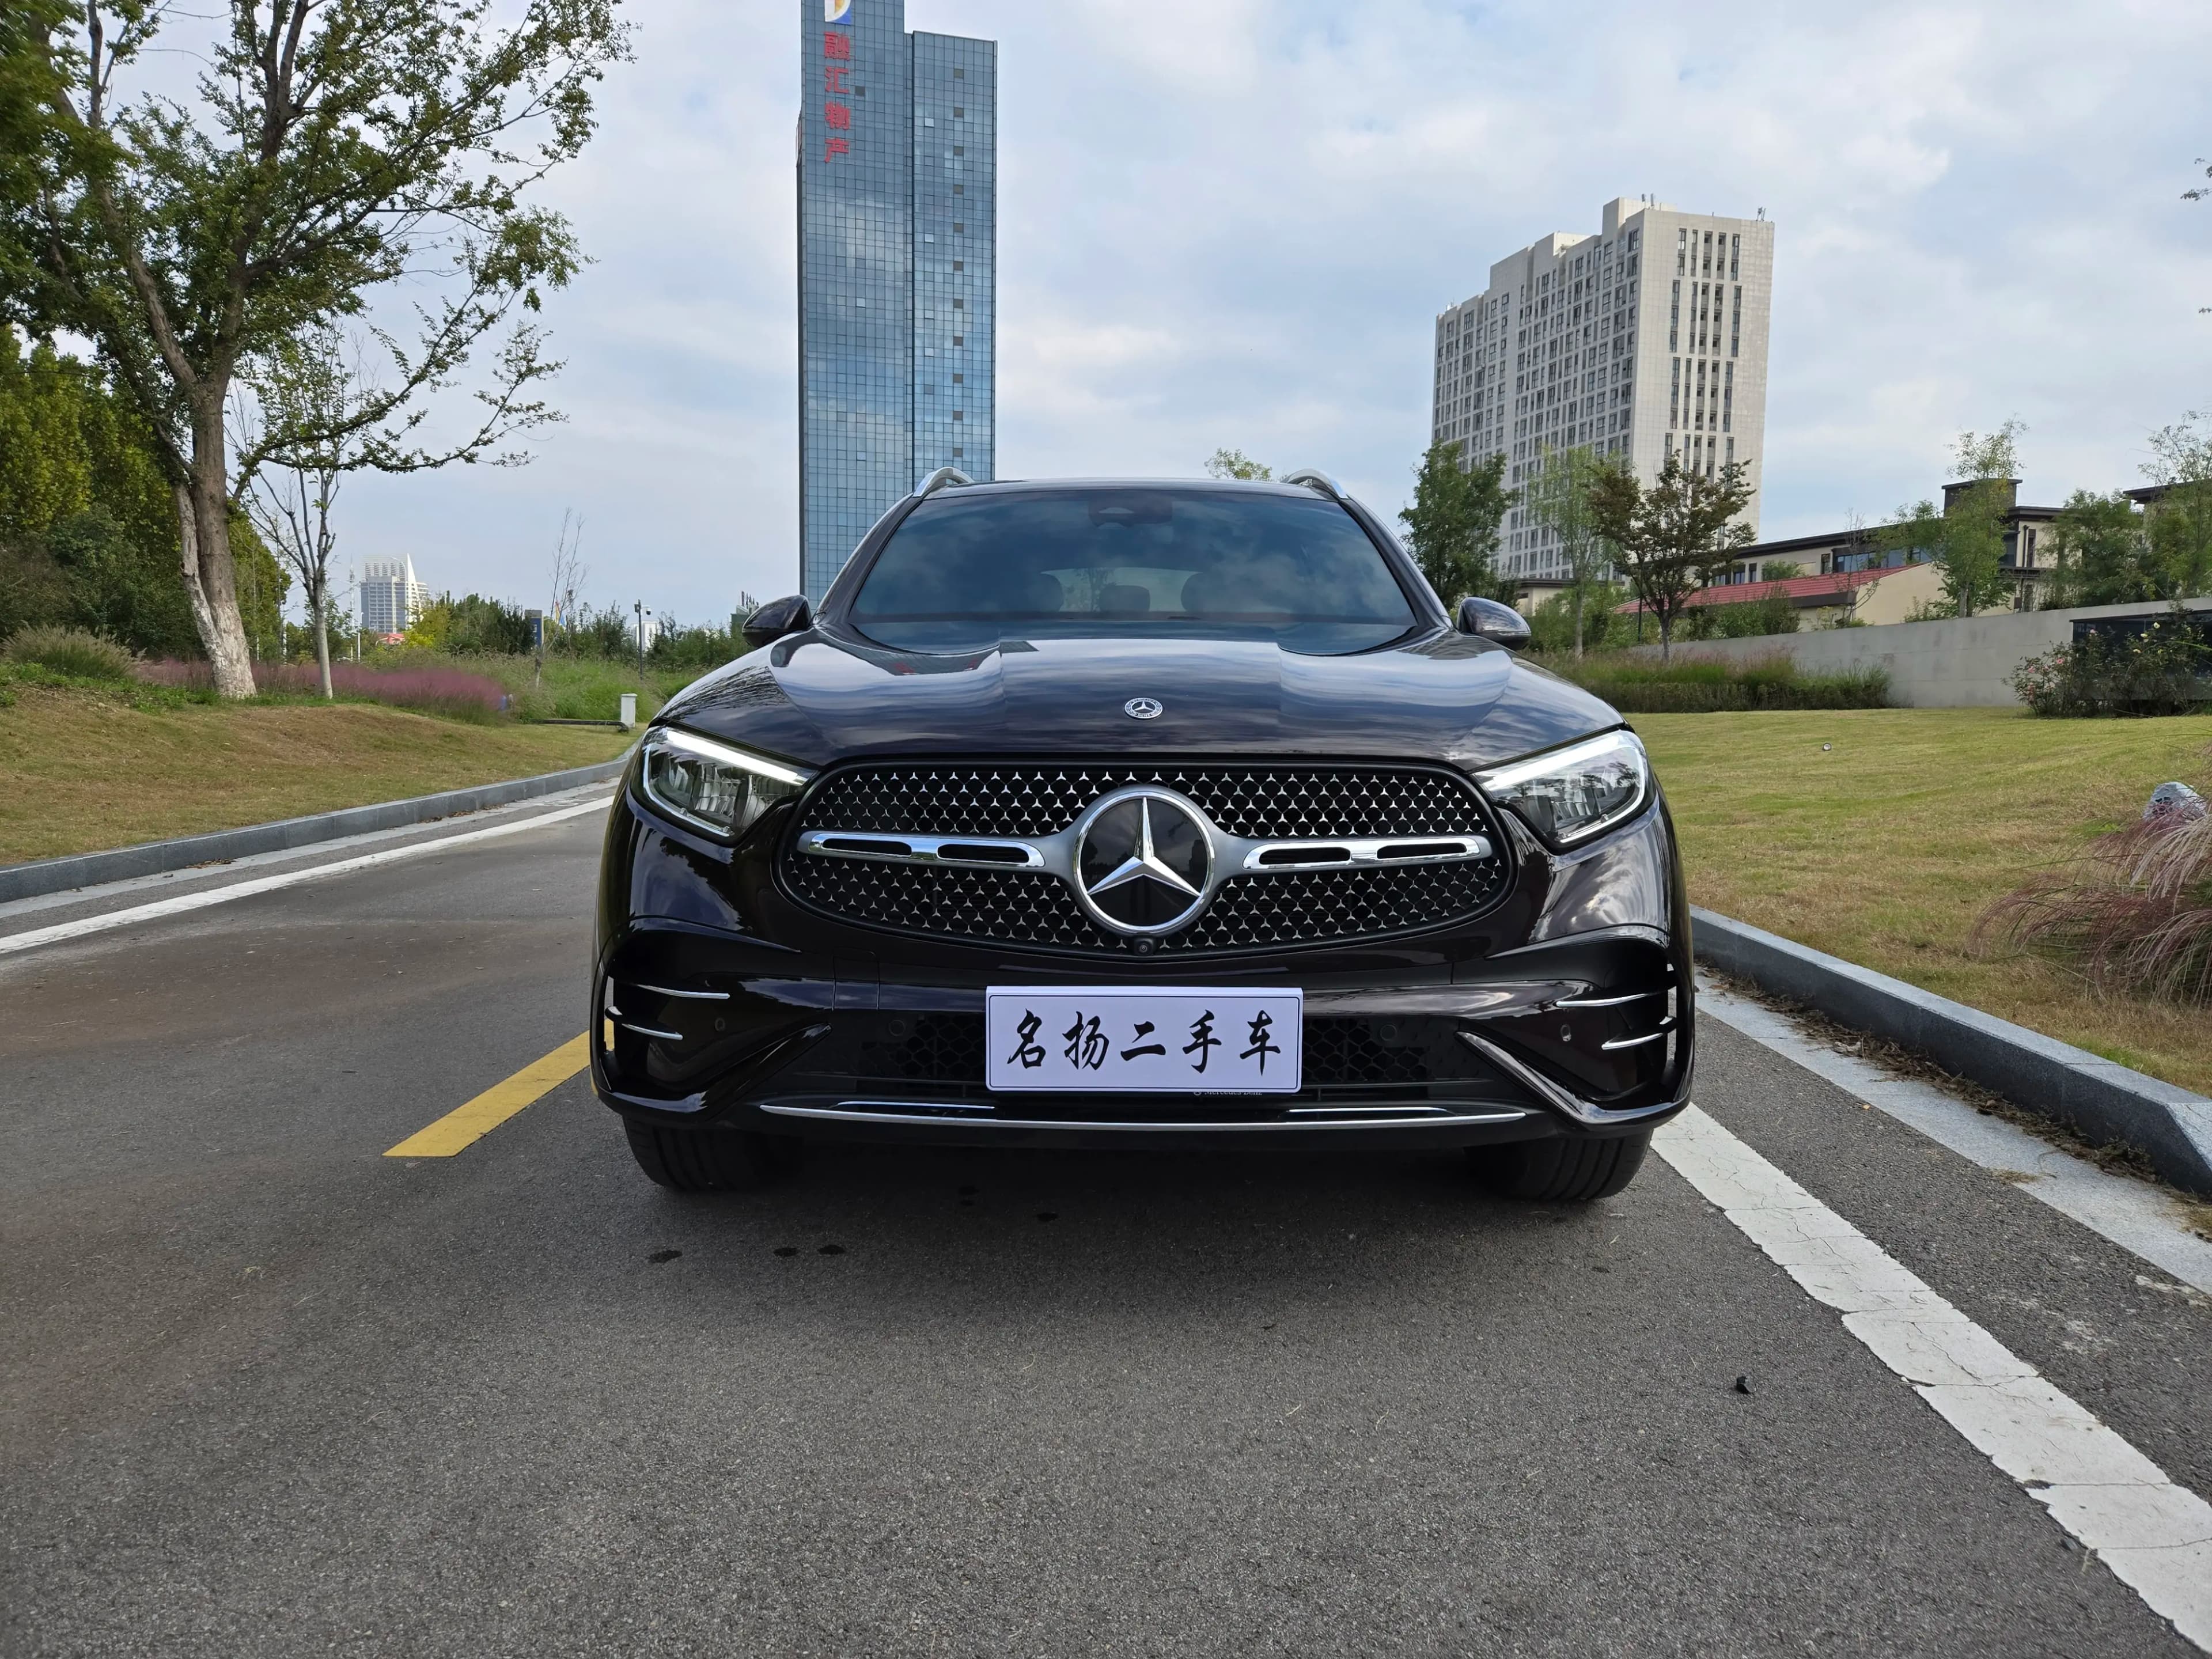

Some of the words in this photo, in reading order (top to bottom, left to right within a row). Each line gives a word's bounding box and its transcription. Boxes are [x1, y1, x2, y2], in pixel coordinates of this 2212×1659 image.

[824, 31, 850, 164] 融汇物产
[1007, 1008, 1281, 1076] 名扬二手车
